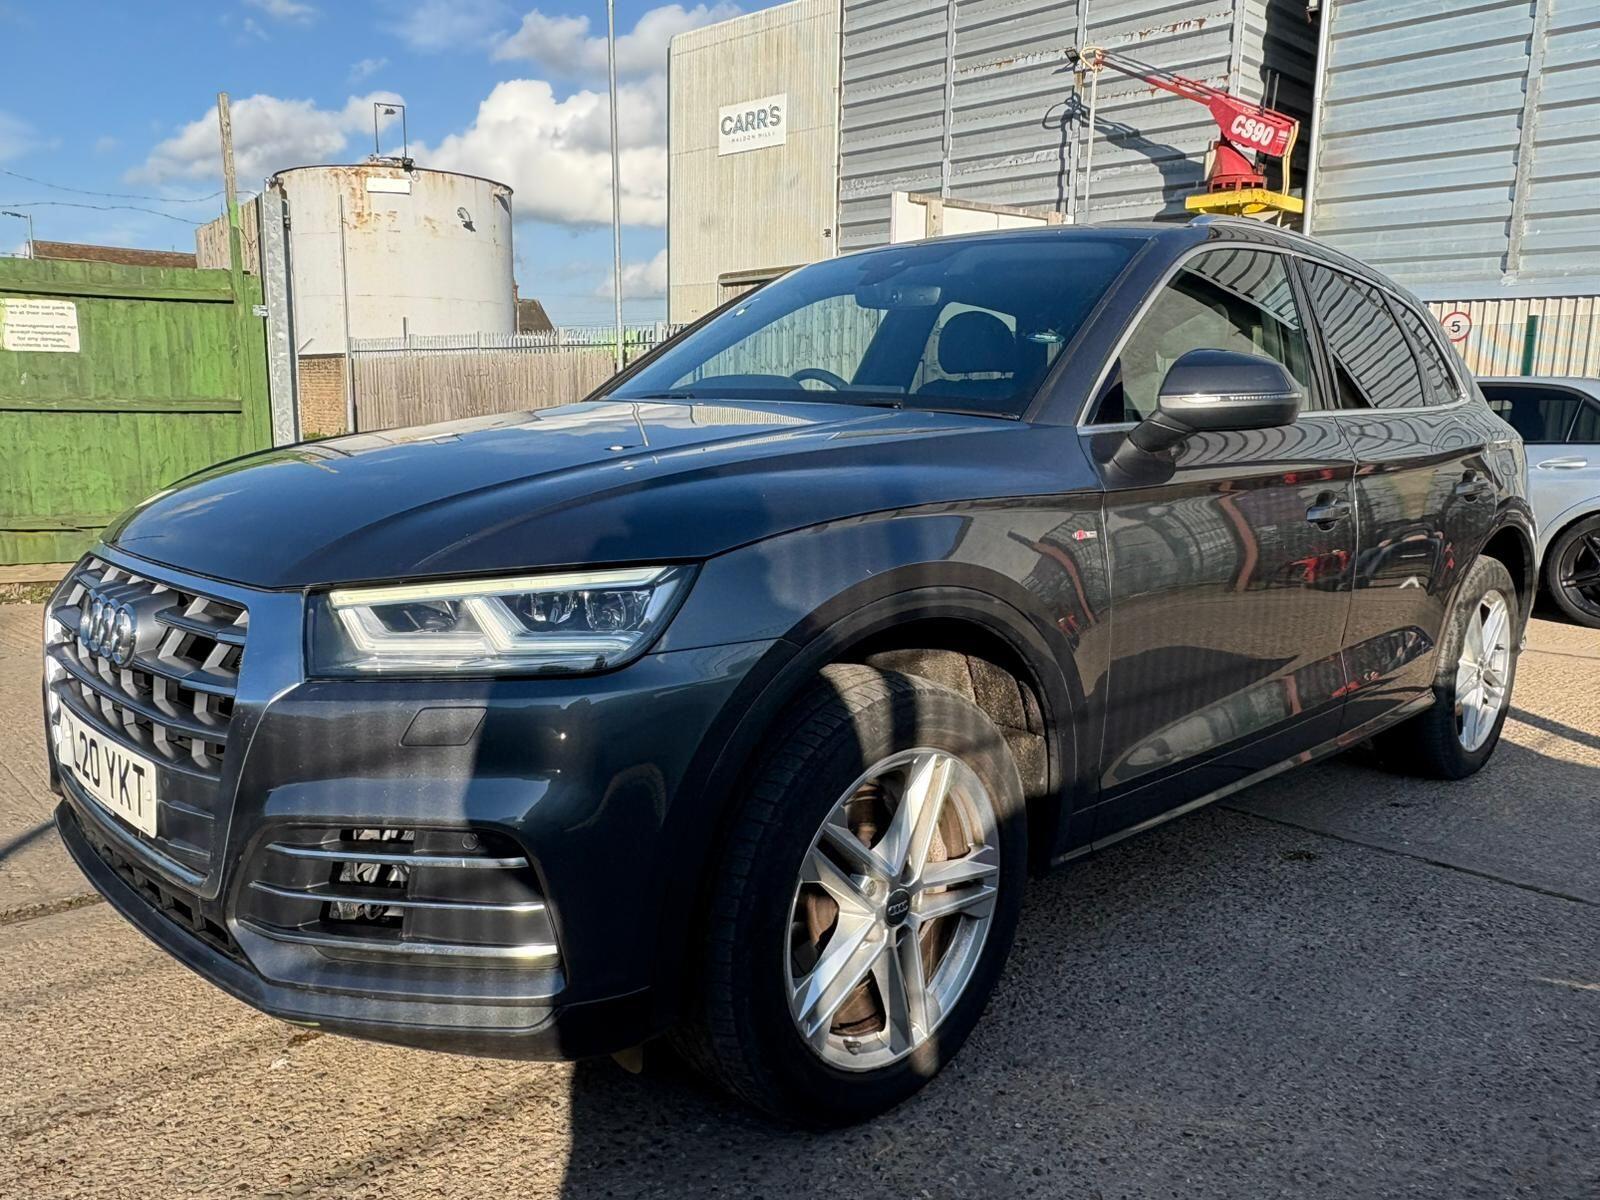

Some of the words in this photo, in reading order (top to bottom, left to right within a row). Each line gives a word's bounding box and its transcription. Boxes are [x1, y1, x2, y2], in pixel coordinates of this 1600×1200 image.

[720, 104, 781, 135] CARR'S
[1231, 115, 1275, 146] CS90
[1451, 320, 1460, 333] 5
[104, 746, 146, 818] YKT
